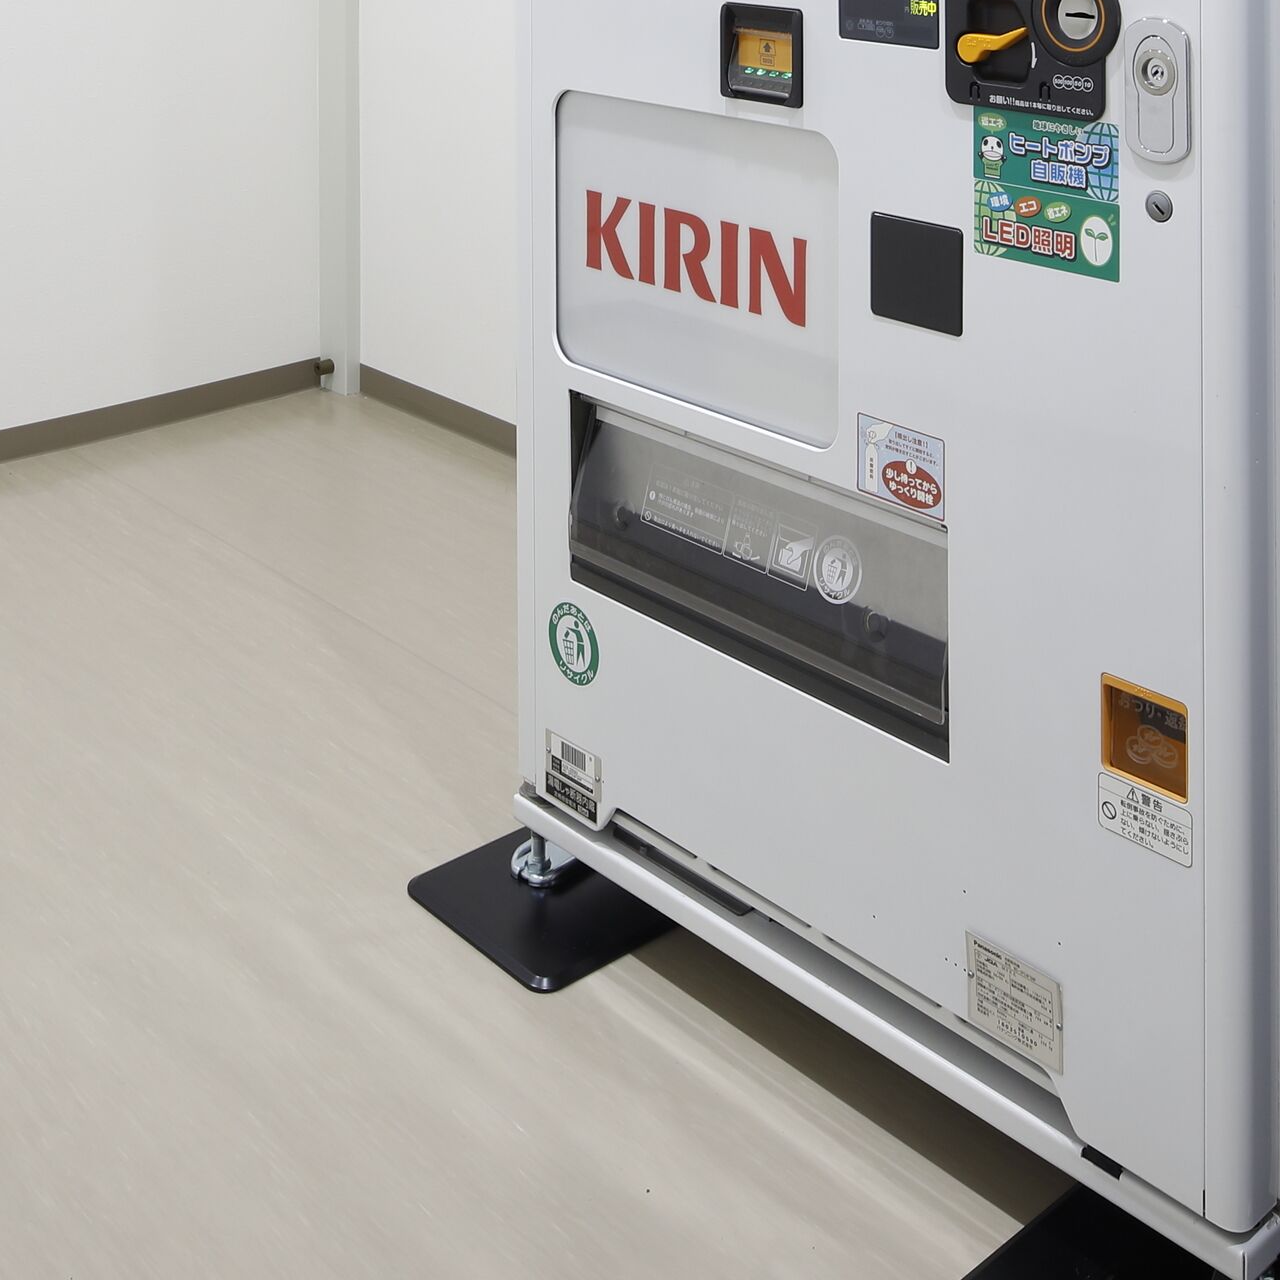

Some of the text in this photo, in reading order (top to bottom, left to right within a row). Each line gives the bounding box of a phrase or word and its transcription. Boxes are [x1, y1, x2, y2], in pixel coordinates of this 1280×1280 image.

[910, 0, 936, 16] 販売中
[1009, 133, 1109, 166] ヒートポンプ
[1031, 160, 1085, 188] 自販機
[990, 194, 1009, 207] 環境
[1019, 201, 1037, 212] エコ
[1047, 206, 1068, 218] 省エネ
[982, 217, 1075, 259] LED照明
[585, 189, 807, 328] KIRIN
[886, 468, 937, 494] 少し待ってから
[552, 604, 591, 632] のんだあとは
[560, 660, 593, 683] リサイクル
[1141, 794, 1163, 812] 警告
